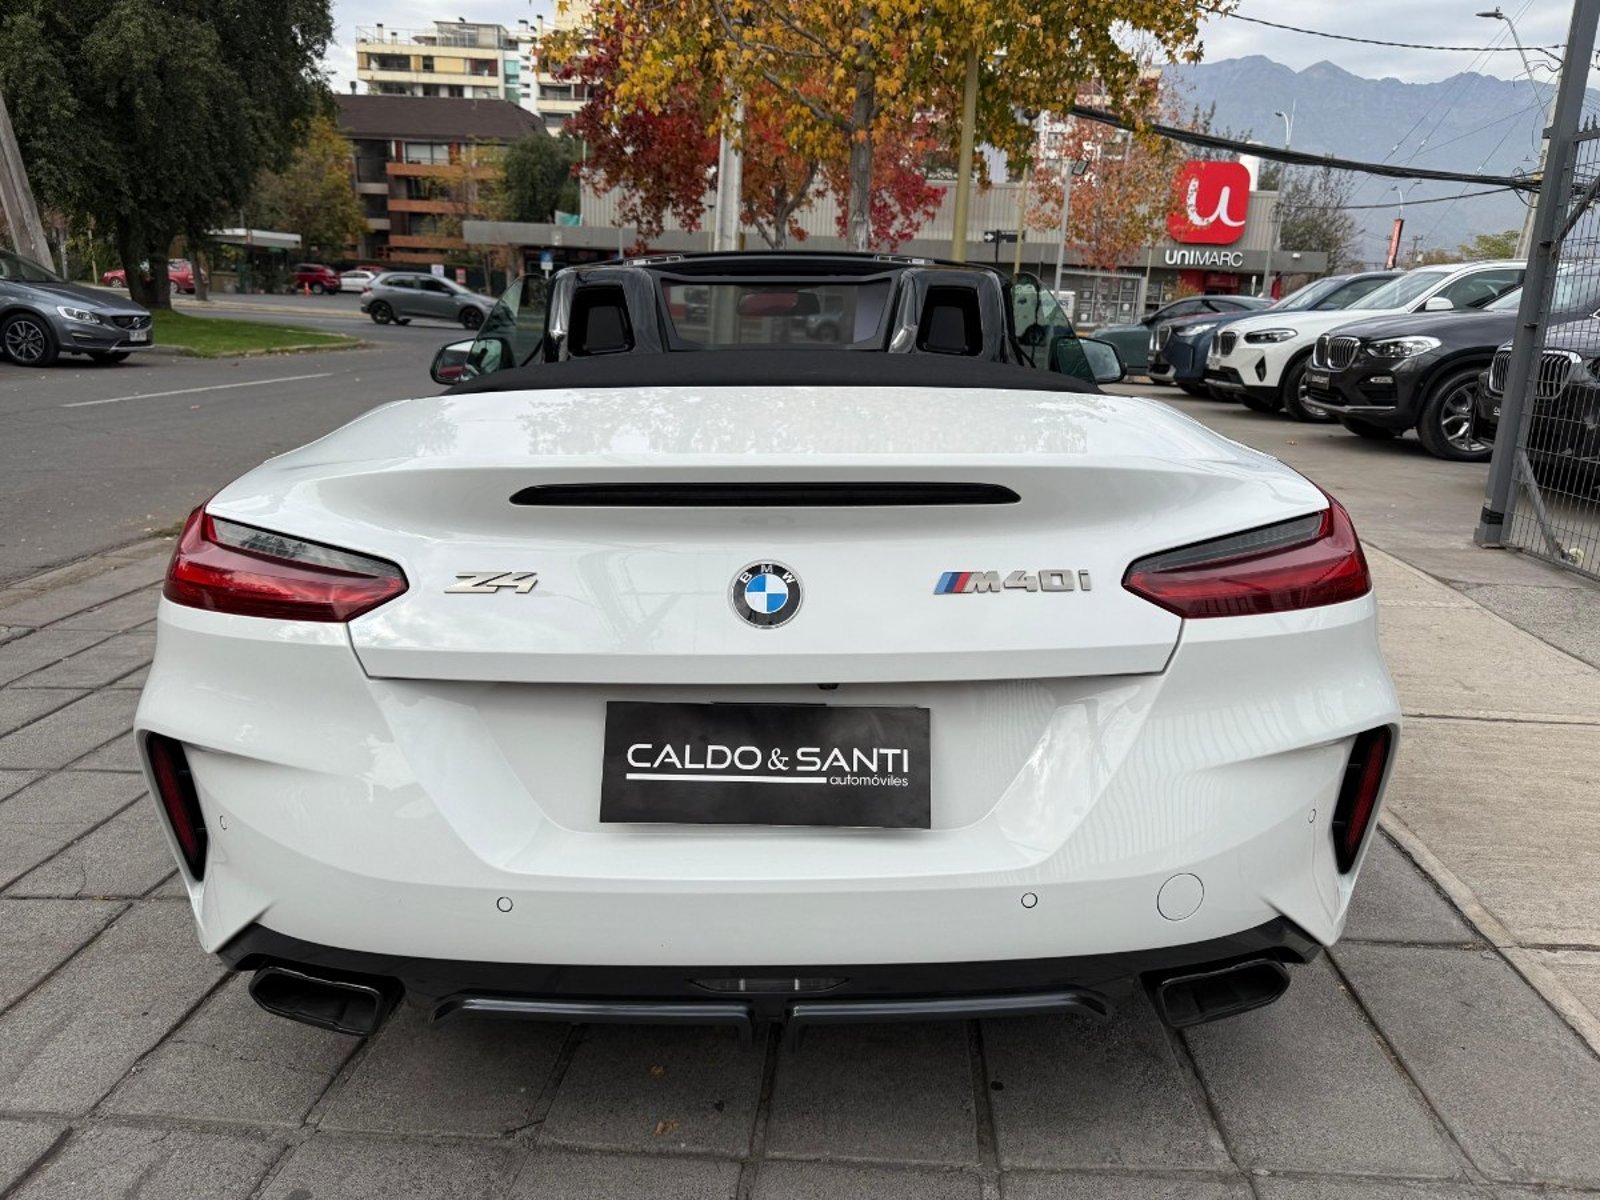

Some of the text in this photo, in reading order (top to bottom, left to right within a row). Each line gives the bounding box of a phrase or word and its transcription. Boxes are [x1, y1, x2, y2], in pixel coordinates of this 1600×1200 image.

[444, 571, 538, 594] Z4
[740, 564, 796, 584] BMW
[962, 569, 1092, 594] M40i
[626, 743, 909, 773] CALDO & SANTI
[829, 774, 909, 787] automóviles
